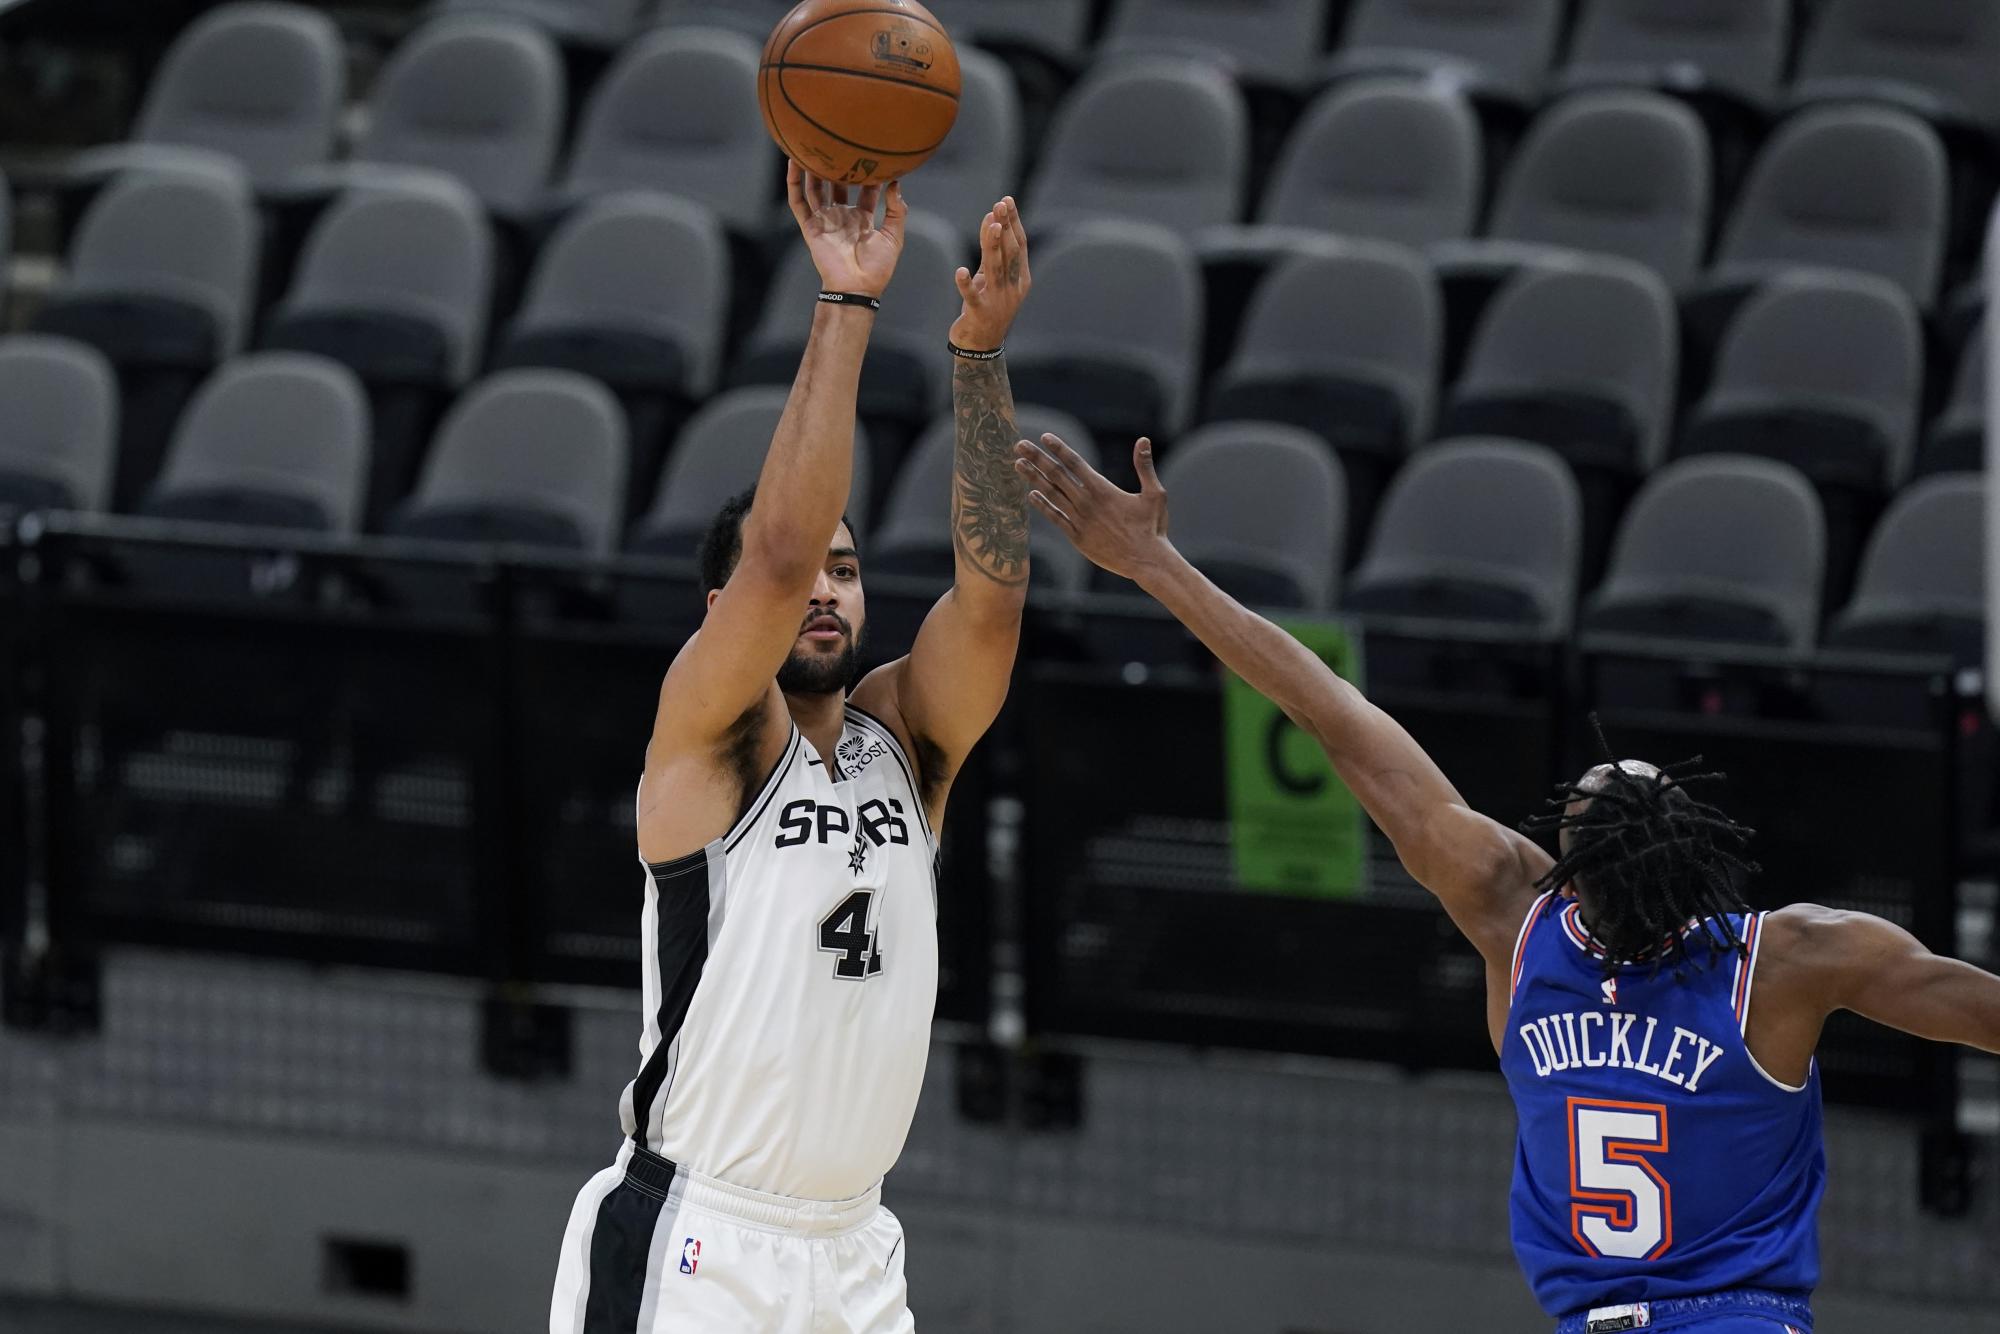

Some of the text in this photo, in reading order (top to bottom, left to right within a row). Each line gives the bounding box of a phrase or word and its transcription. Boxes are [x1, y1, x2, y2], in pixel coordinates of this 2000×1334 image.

[844, 740, 888, 779] Frost
[775, 798, 909, 860] SPRS
[817, 887, 883, 982] 4
[1520, 1011, 1724, 1092] QUICKLEY
[1567, 1096, 1673, 1262] 5
